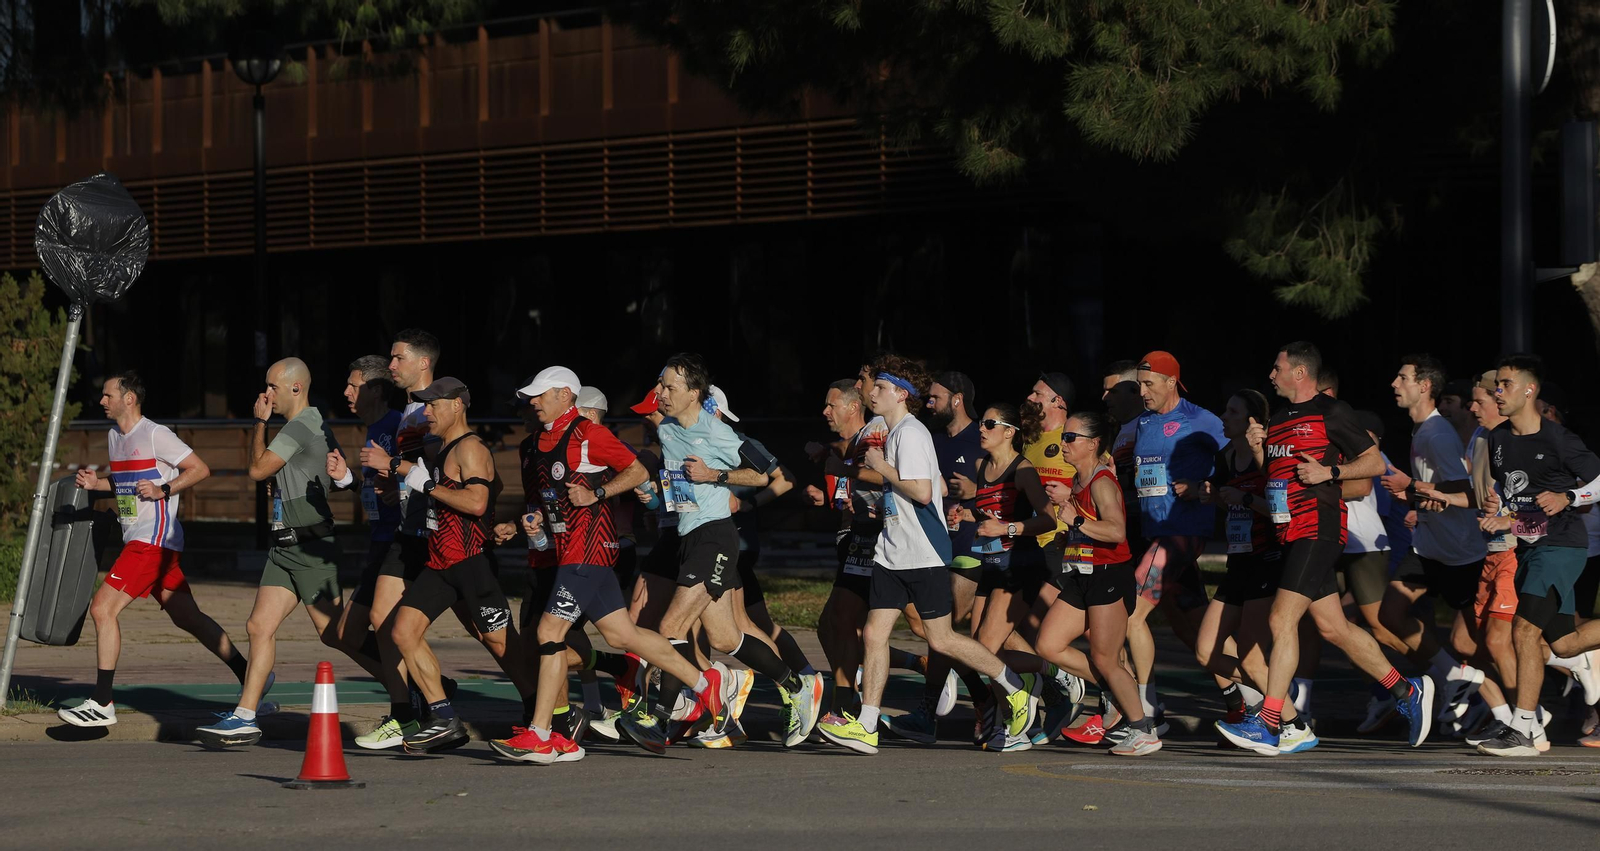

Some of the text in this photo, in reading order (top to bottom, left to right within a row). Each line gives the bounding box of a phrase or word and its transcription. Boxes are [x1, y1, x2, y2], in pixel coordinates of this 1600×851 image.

[1267, 444, 1295, 457] PAAC
[1140, 477, 1158, 487] MANU
[710, 553, 729, 587] LDN
